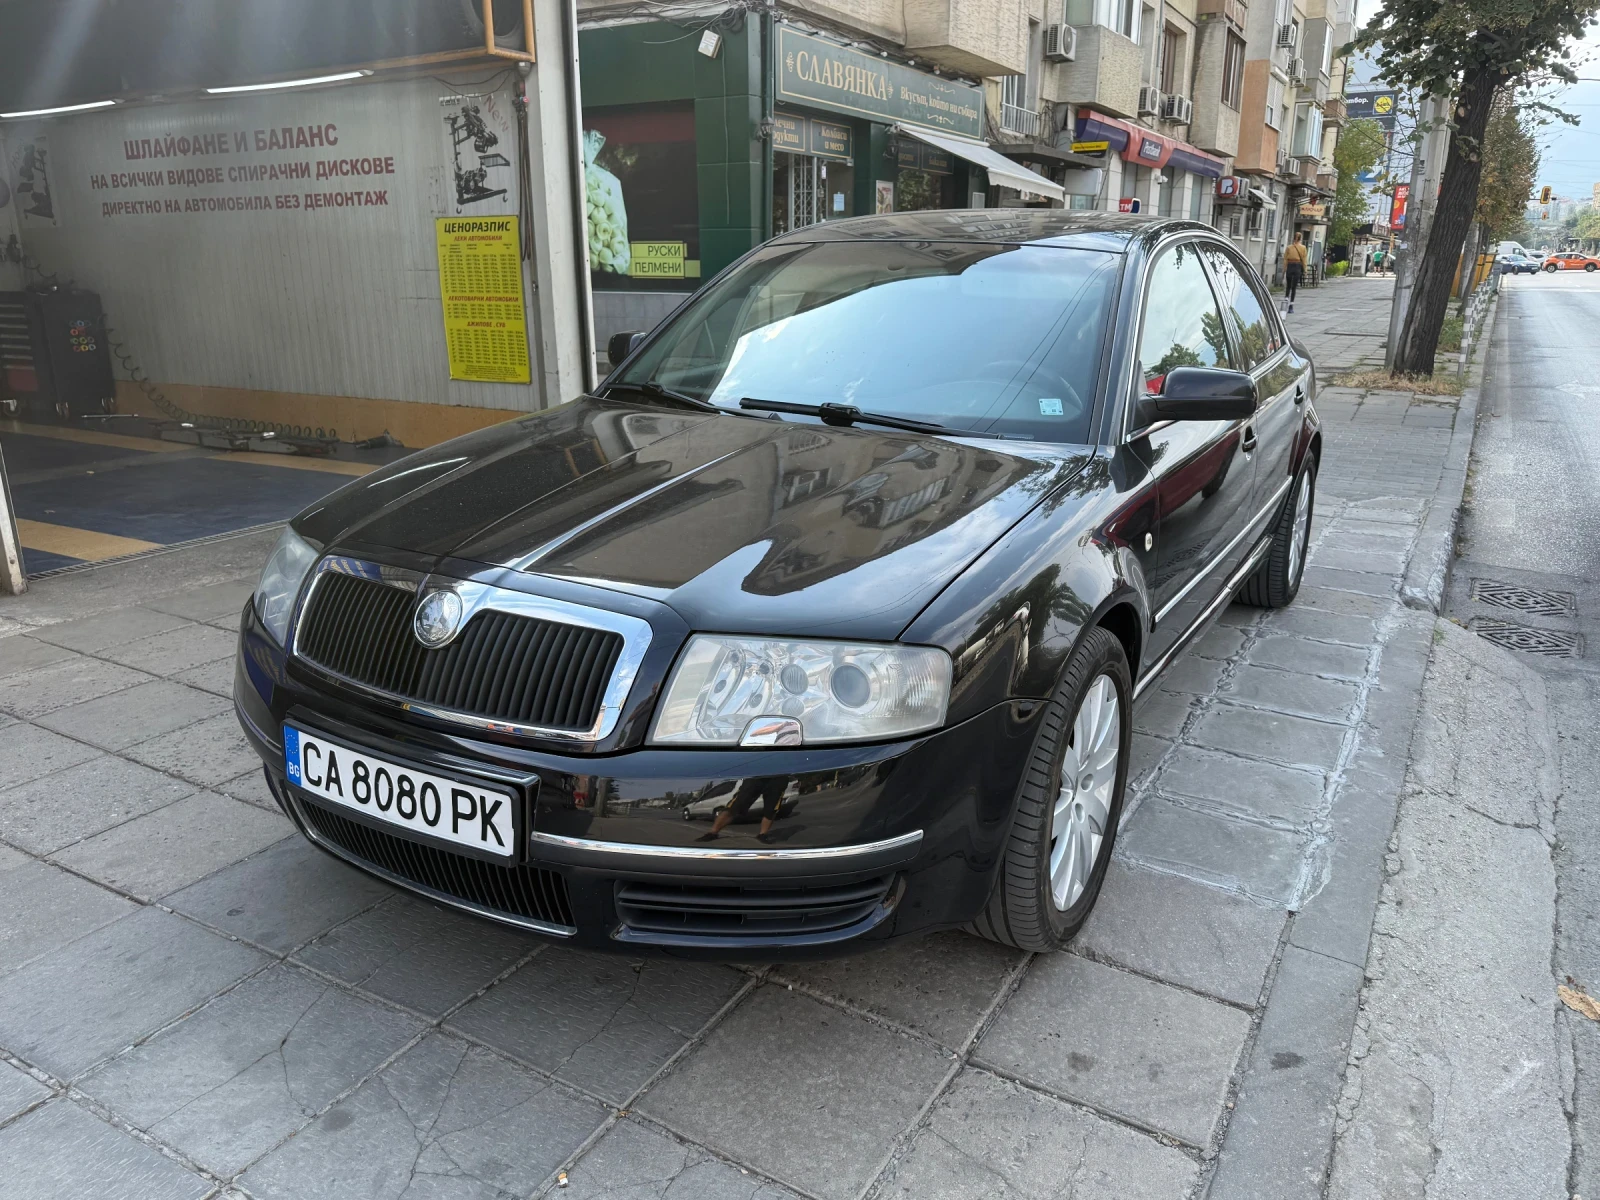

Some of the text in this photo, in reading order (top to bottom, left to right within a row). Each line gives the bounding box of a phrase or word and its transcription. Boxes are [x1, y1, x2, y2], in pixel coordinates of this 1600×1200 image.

[797, 51, 887, 101] СЛАВЯНКА
[484, 93, 509, 133] New
[929, 94, 949, 111] който
[950, 103, 957, 113] ни
[958, 104, 977, 121] събира
[774, 119, 795, 130] лечни
[821, 126, 848, 140] Колбаси
[124, 123, 338, 160] ШЛАЙФАНЕ И БАЛАНС
[825, 141, 845, 152] и месо
[91, 157, 395, 190] НА ВСИЧКИ ВИДОВЕ СПИРАЧНИ ДИСКОВЕ
[102, 190, 388, 218] ДИРЕКТНО НА АВТОМОБИЛА БЕЗ ДЕМОНТАЖ
[444, 221, 511, 234] ЦЕНОРАЗПИС
[648, 245, 681, 256] РУСКИ
[635, 262, 682, 273] ПЕЛМЕНИ
[288, 761, 300, 778] BG
[303, 741, 505, 848] CA 8080 PK
